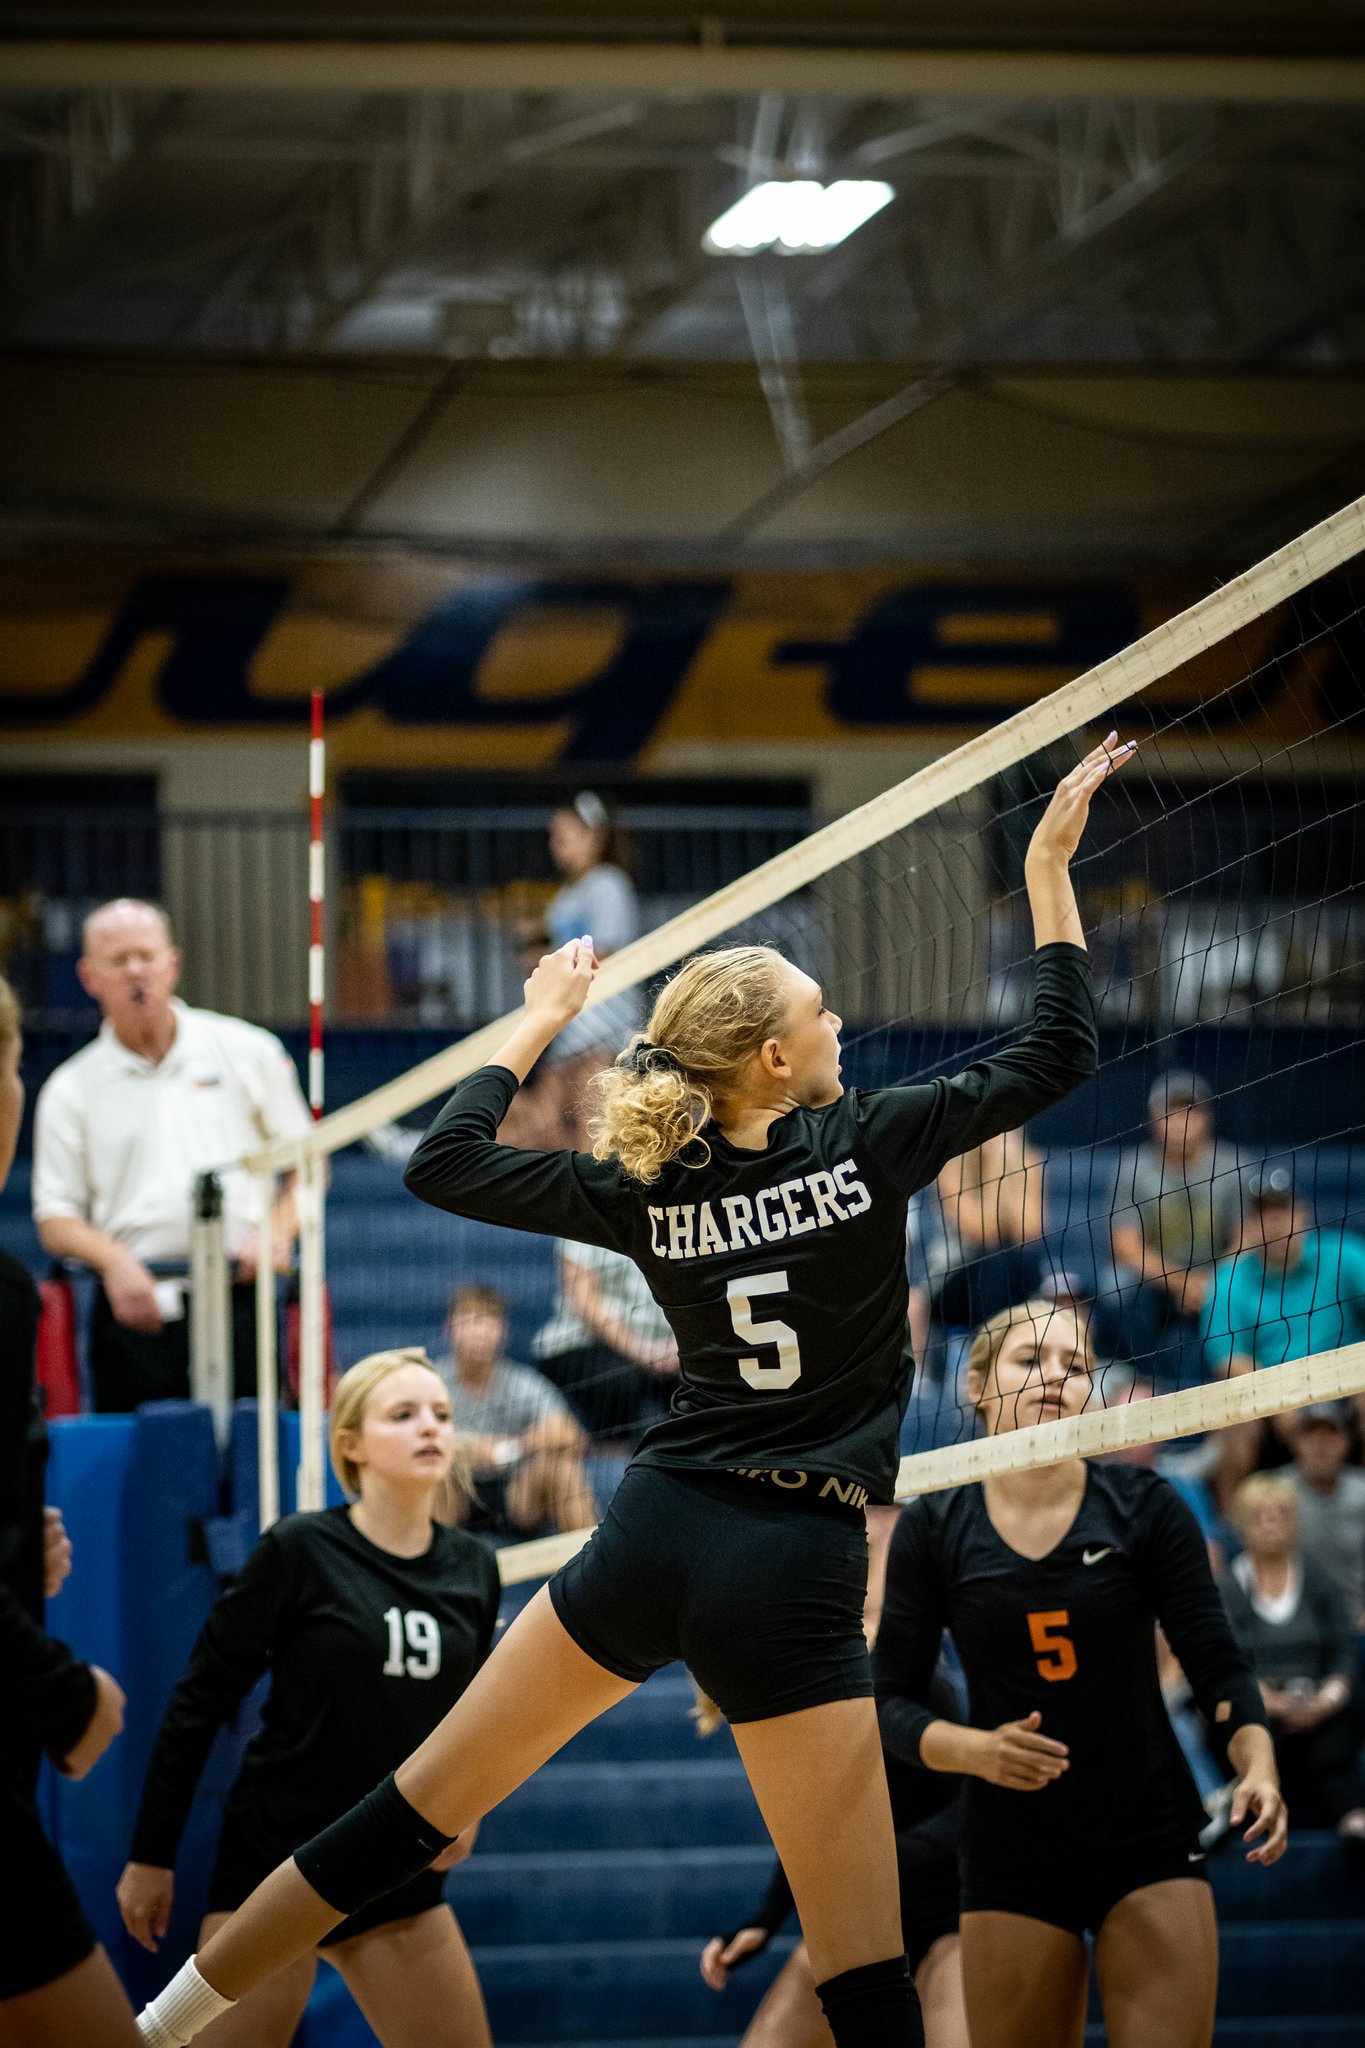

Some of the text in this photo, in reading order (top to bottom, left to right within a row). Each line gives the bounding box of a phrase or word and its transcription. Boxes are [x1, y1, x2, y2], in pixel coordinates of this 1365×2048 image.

[647, 1158, 872, 1260] CHARGERS
[726, 1270, 802, 1391] 5
[383, 1606, 441, 1679] 19
[1026, 1609, 1078, 1681] 5
